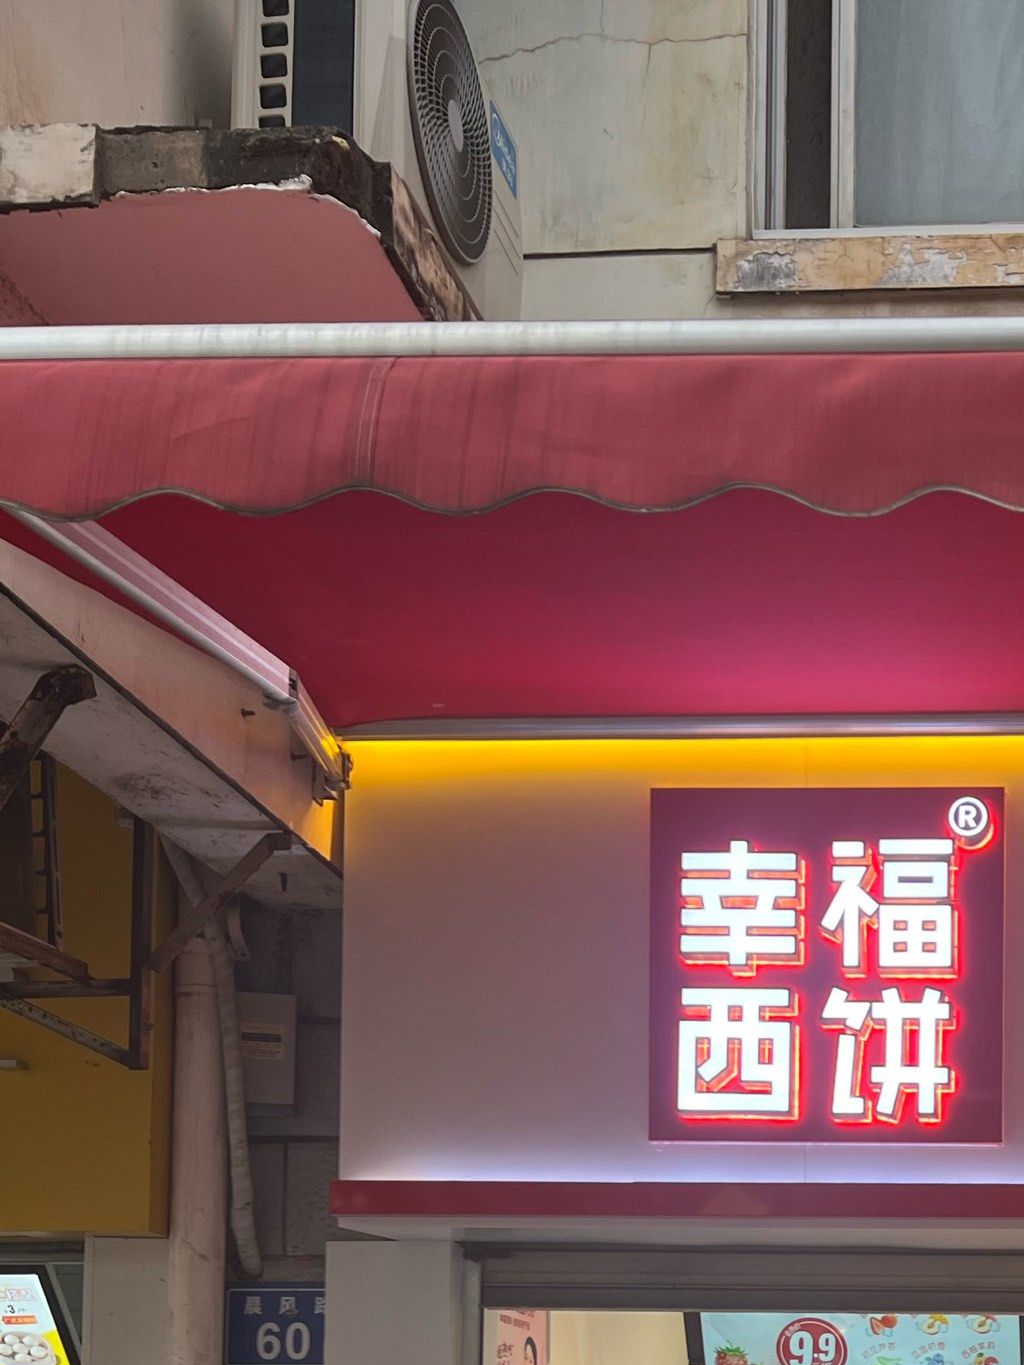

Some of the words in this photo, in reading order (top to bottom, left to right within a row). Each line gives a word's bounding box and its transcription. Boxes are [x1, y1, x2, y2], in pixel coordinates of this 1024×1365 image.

[680, 839, 955, 970] 幸福
[677, 986, 953, 1117] 西饼
[256, 1322, 311, 1360] 60
